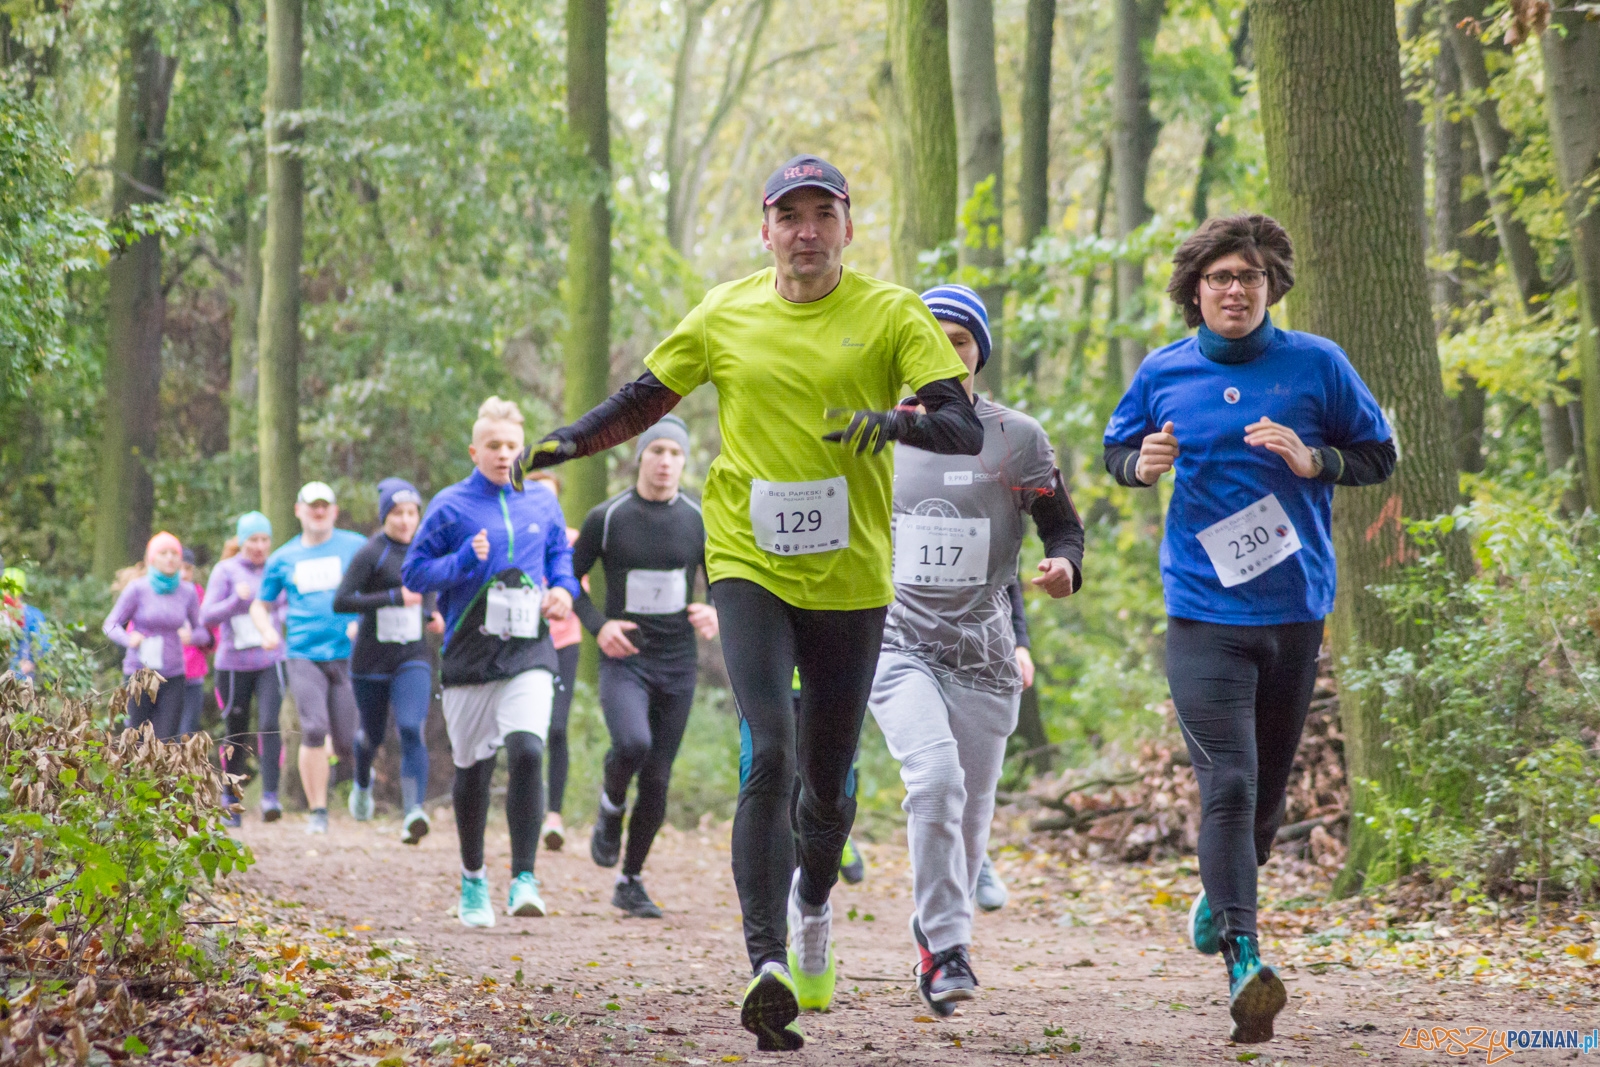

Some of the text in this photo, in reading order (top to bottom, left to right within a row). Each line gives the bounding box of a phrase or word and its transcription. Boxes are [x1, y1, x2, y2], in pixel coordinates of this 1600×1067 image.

[775, 509, 822, 534] 129
[1227, 526, 1270, 560] 230
[919, 544, 964, 567] 117
[652, 587, 662, 600] 7
[504, 606, 530, 623] 131
